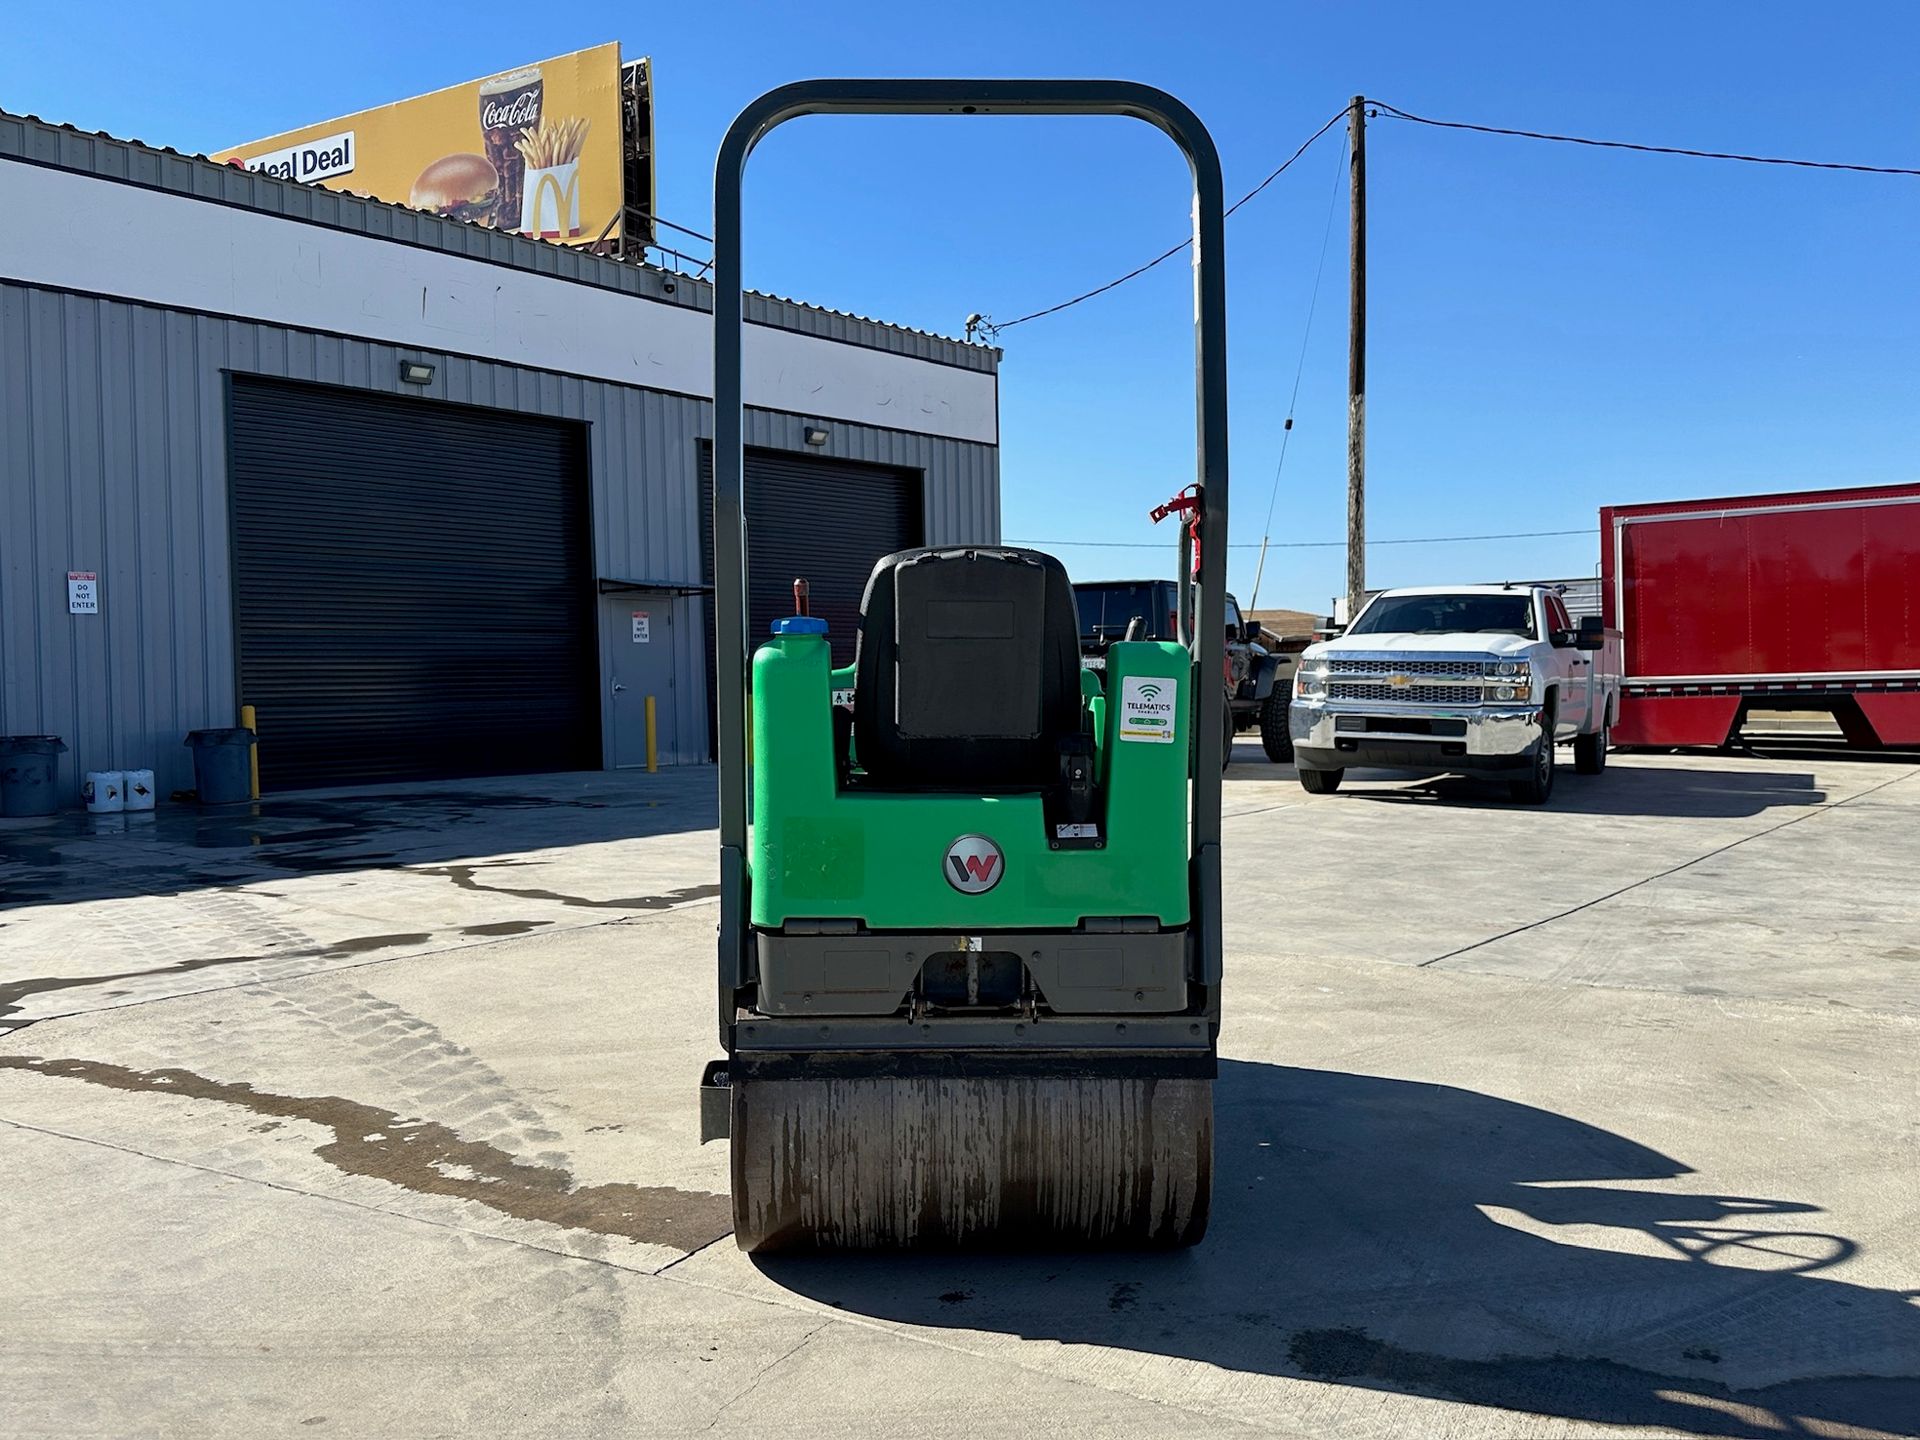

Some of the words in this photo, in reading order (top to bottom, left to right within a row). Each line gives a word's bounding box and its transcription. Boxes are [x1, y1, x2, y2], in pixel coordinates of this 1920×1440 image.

[482, 88, 541, 131] Coca-Cola
[250, 151, 298, 180] eal
[302, 138, 350, 176] Deal
[75, 592, 91, 600] NOT
[71, 601, 96, 609] ENTER
[1127, 702, 1171, 712] TELEMATICS
